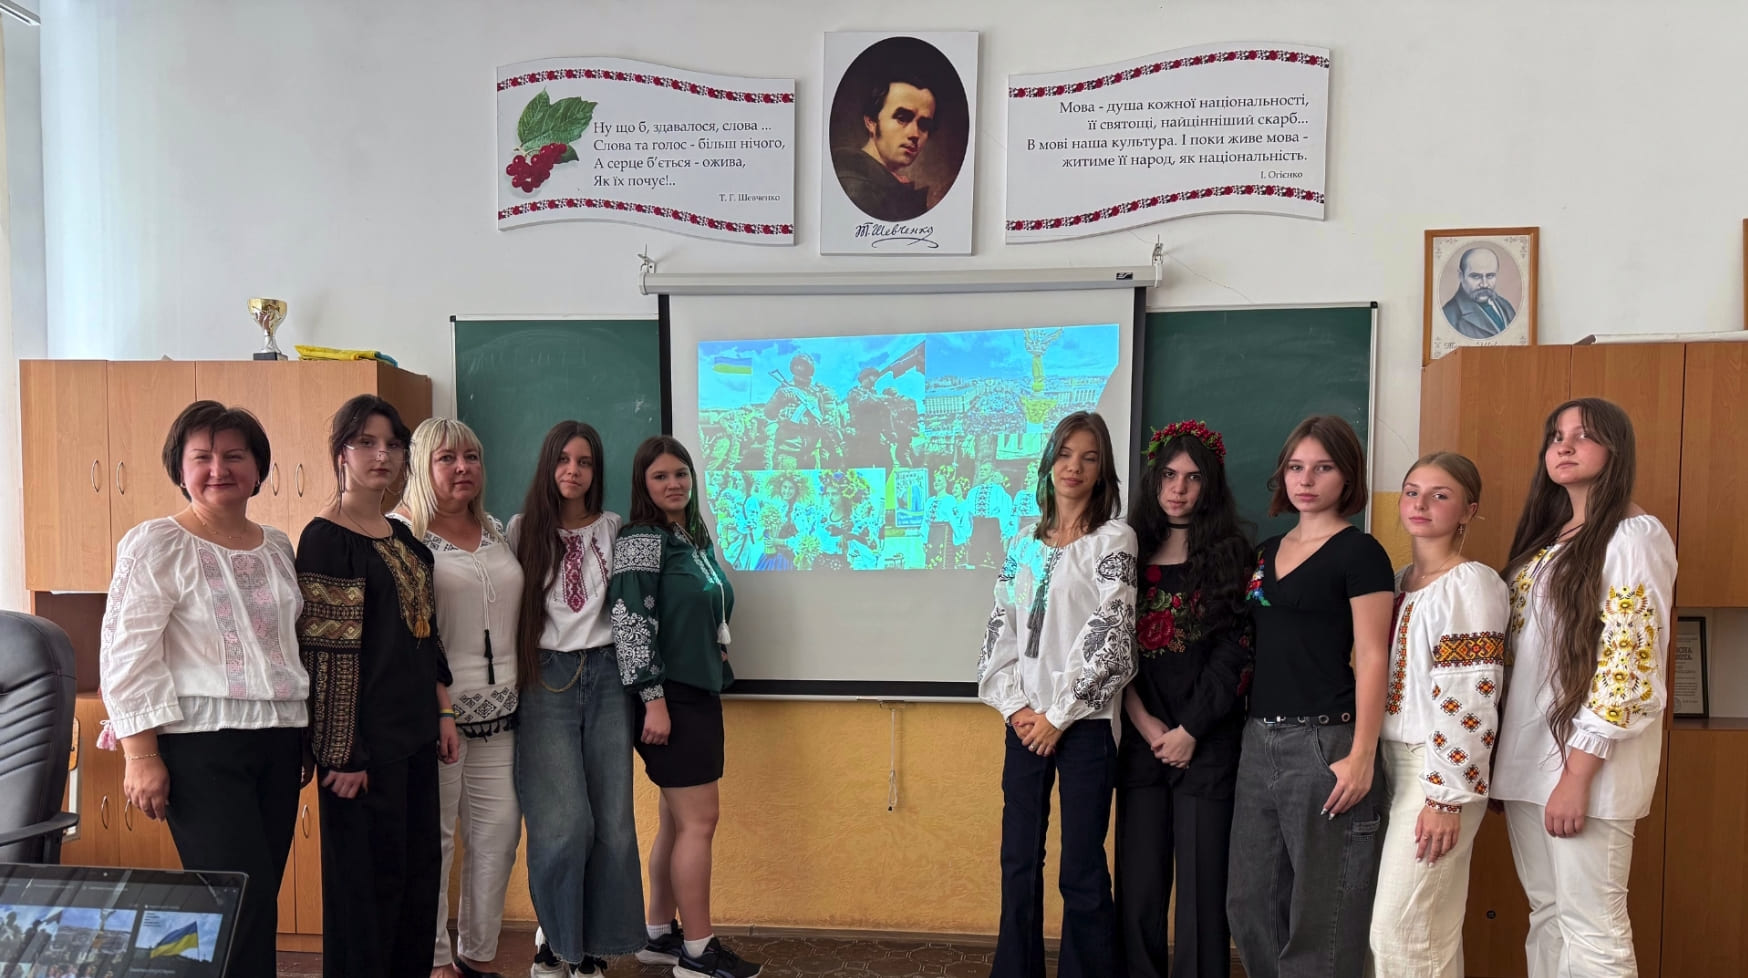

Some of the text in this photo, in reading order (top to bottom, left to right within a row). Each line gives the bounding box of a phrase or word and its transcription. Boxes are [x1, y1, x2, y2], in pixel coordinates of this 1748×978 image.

[1060, 101, 1095, 113] Мова
[1106, 102, 1143, 115] душа
[1147, 98, 1196, 110] кожної
[1199, 93, 1309, 109] національності,
[594, 121, 612, 137] Ну
[616, 124, 636, 134] що
[638, 121, 650, 134] б,
[653, 122, 719, 134] здавалося,
[722, 121, 758, 131] слова
[1087, 120, 1097, 130] її
[1161, 114, 1254, 129] найцінніший
[1257, 112, 1309, 127] скарб...
[593, 139, 631, 151] Слова
[635, 142, 648, 150] та
[652, 141, 688, 151] голос
[698, 137, 736, 149] більш
[740, 137, 785, 149] нічого,
[1027, 139, 1036, 151] В
[1039, 138, 1068, 150] мові
[1071, 139, 1108, 149] наша
[1112, 136, 1178, 151] культура.
[1181, 134, 1187, 146] І
[1190, 135, 1225, 146] поки
[1227, 134, 1263, 144] живе
[1266, 133, 1300, 143] мова
[594, 157, 604, 169] А
[607, 159, 644, 172] серце
[702, 158, 746, 168] ожива,
[1062, 149, 1308, 168] житиме її народ, як національність.
[593, 174, 676, 190] Як їх почує!..
